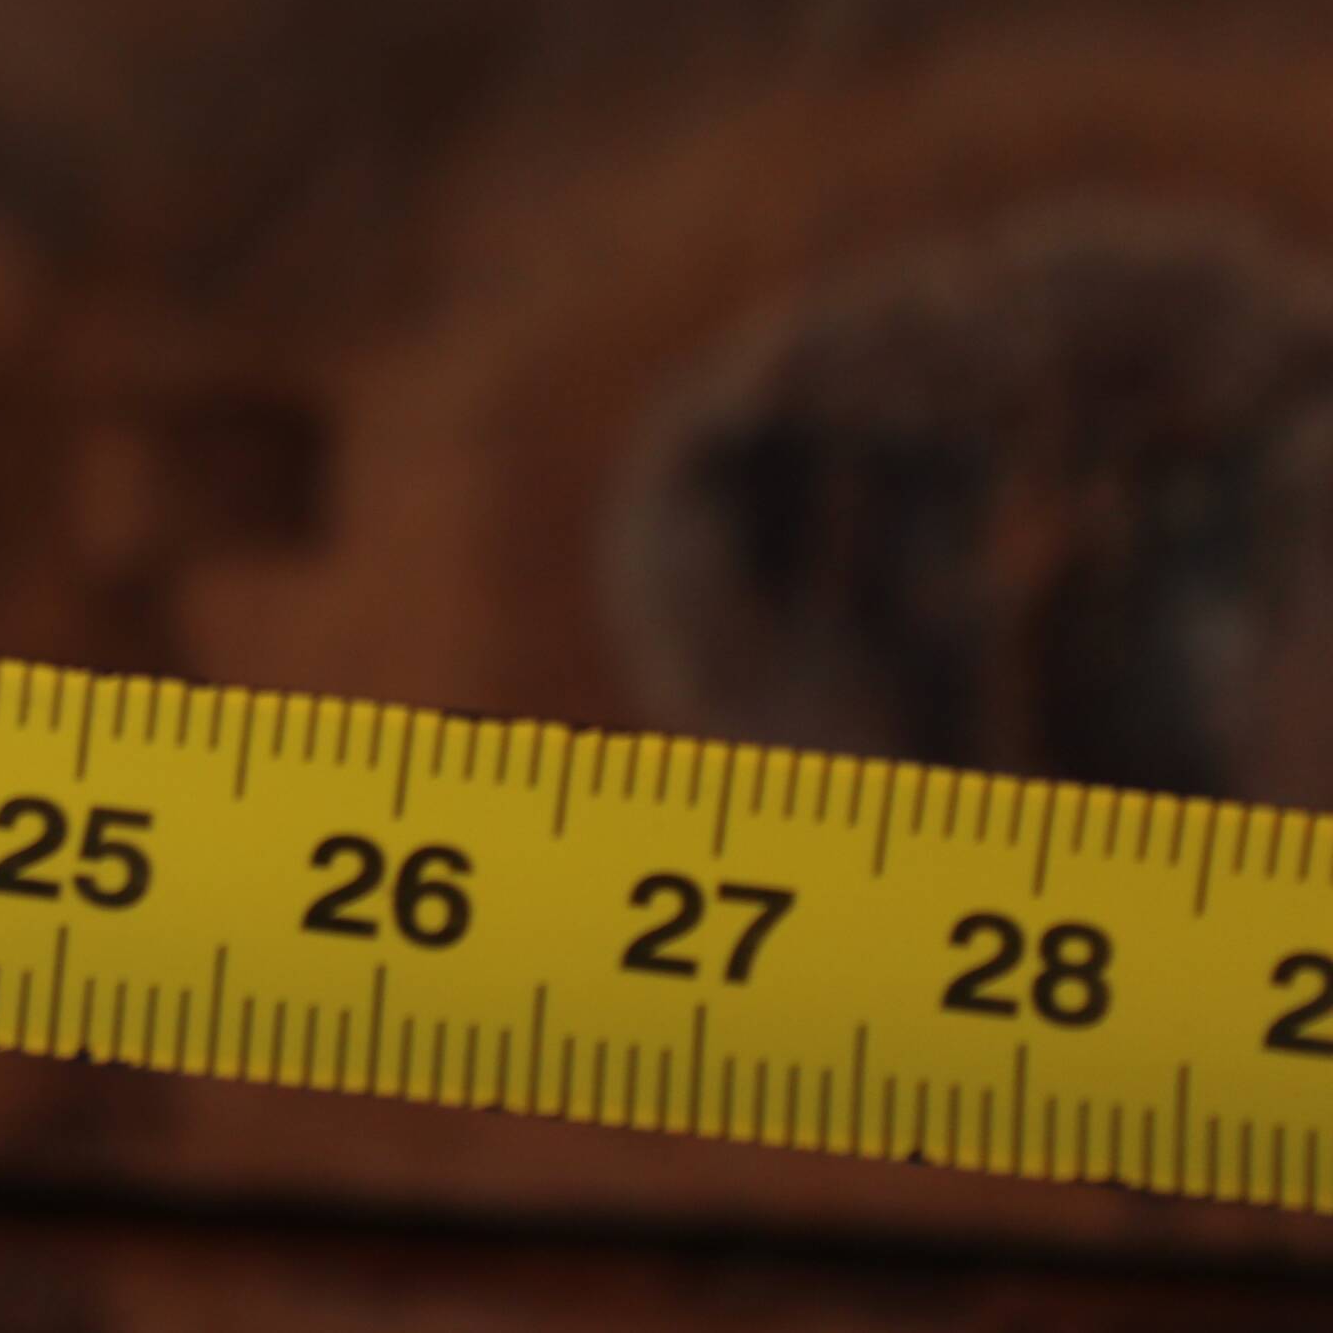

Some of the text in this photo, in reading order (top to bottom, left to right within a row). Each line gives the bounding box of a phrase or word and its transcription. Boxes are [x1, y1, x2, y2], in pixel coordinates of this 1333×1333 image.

[302, 834, 473, 950] 26
[621, 873, 796, 984] 27
[941, 912, 1113, 1029] 28
